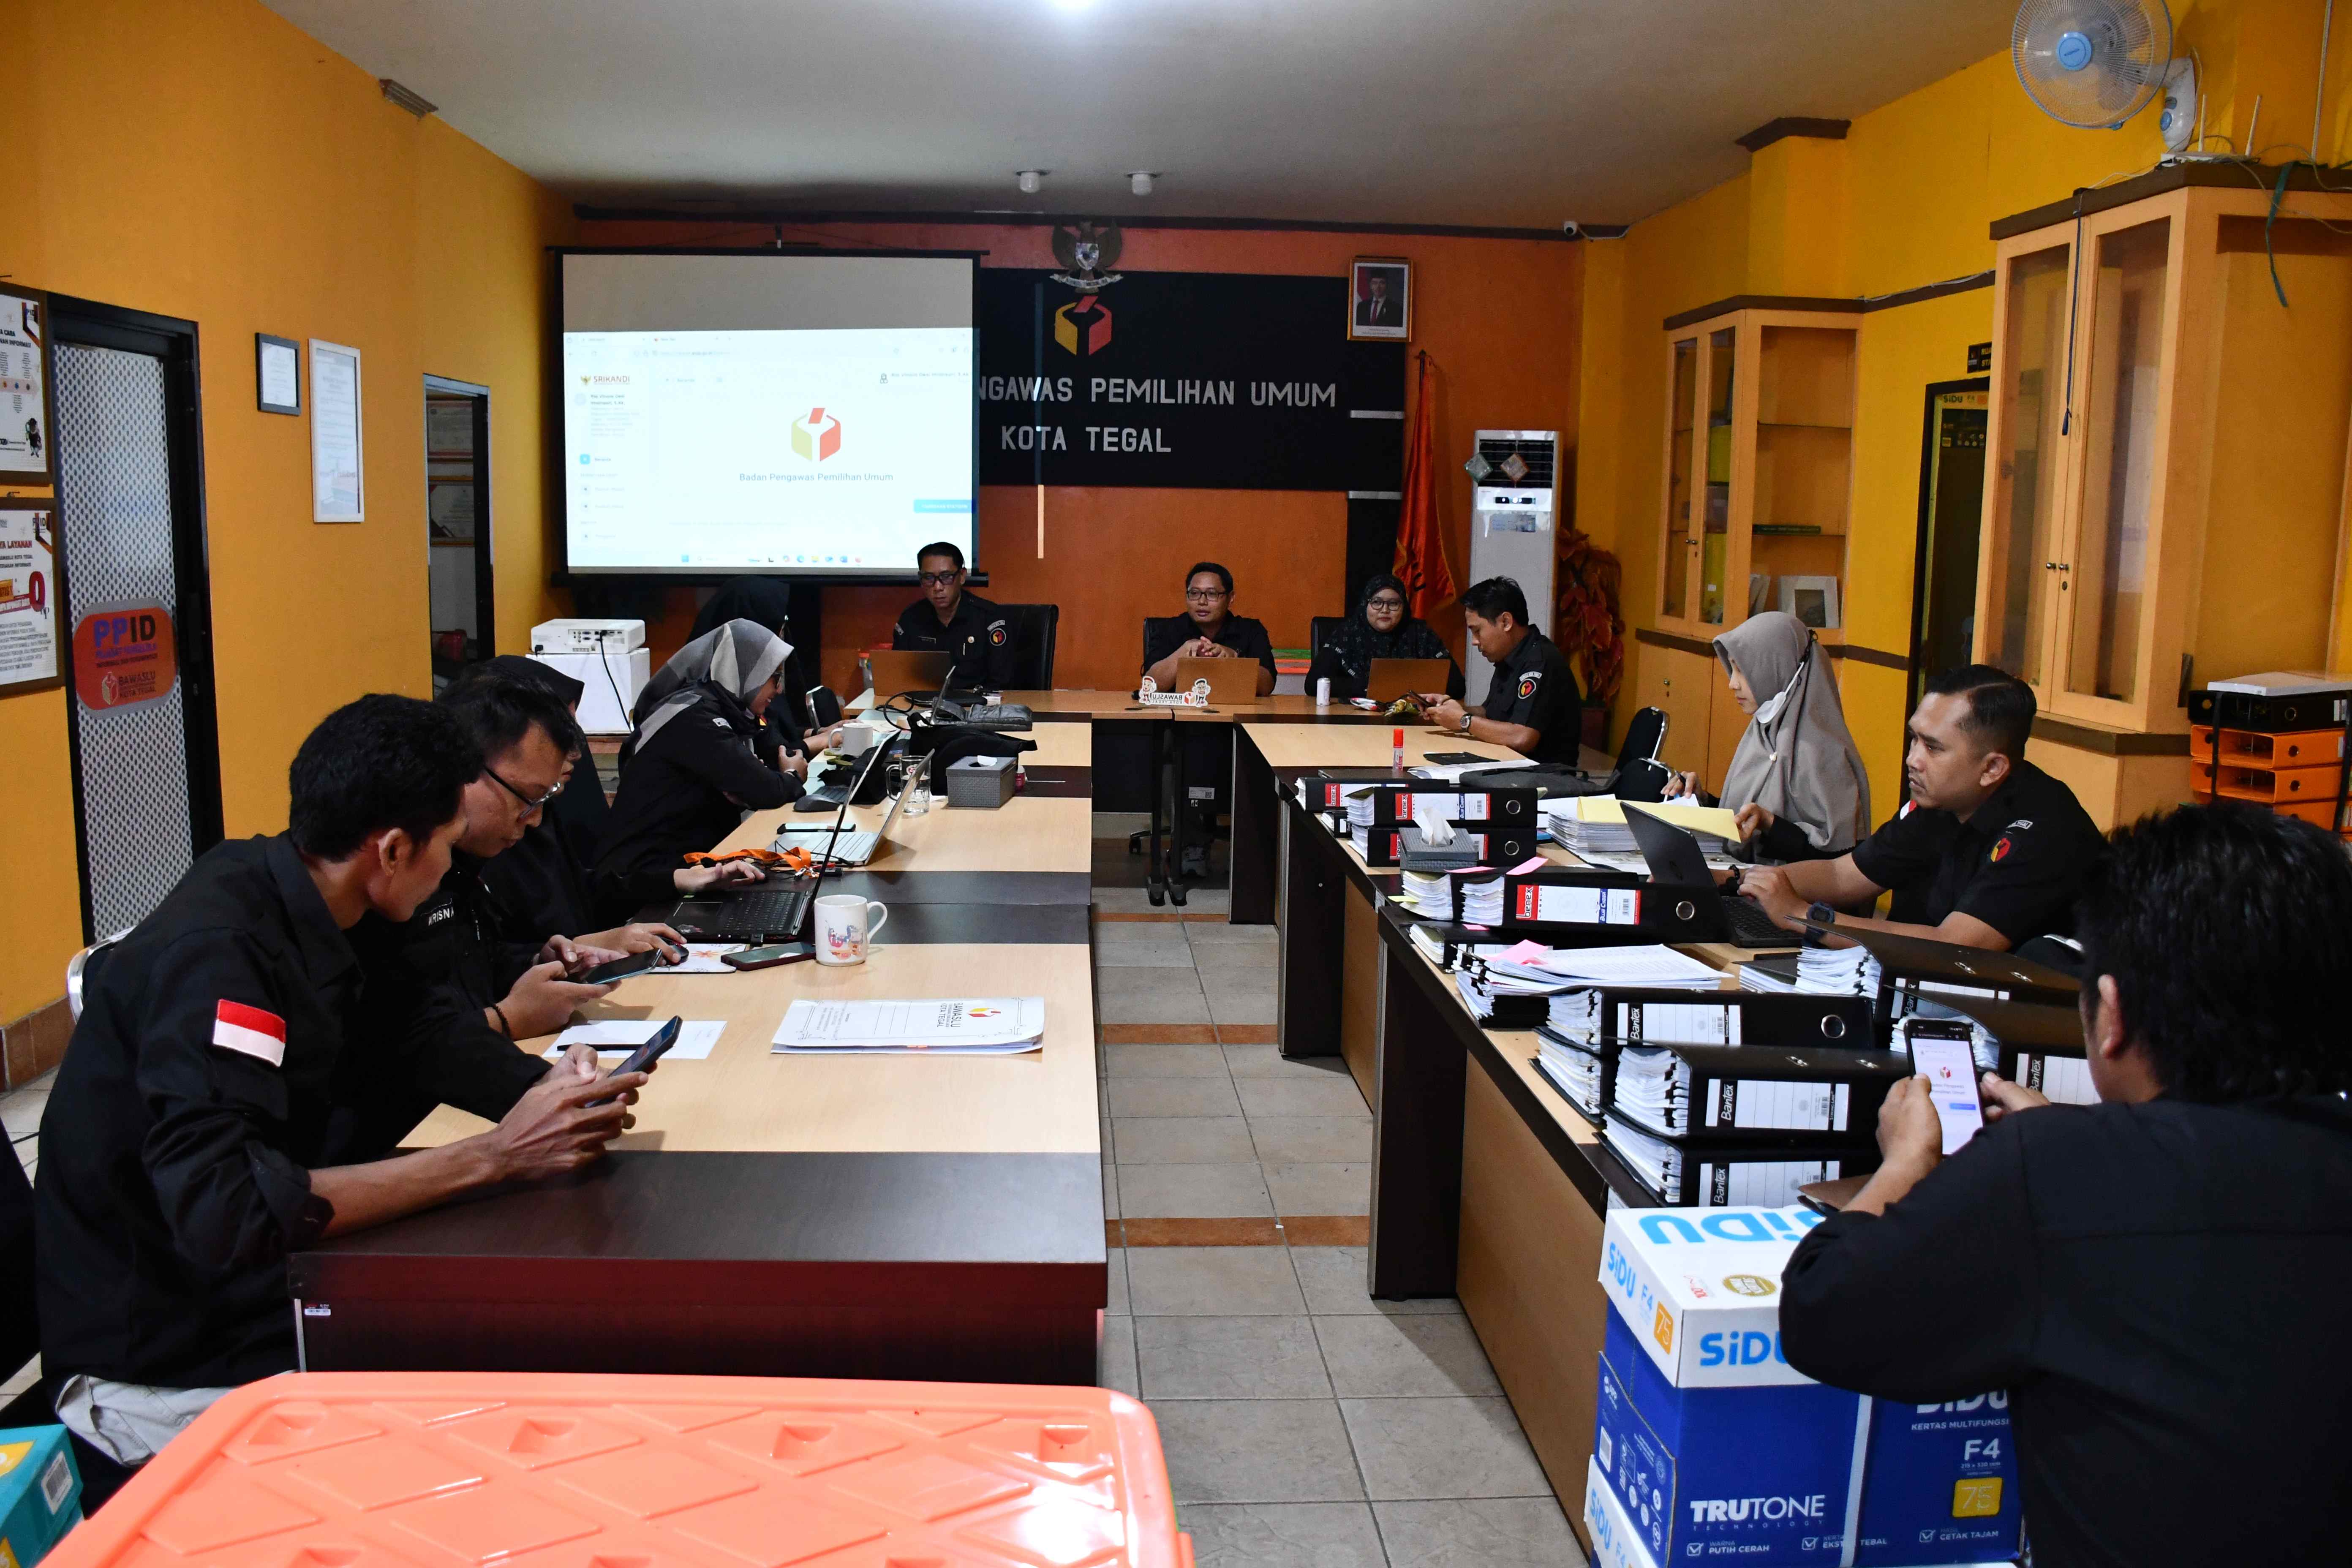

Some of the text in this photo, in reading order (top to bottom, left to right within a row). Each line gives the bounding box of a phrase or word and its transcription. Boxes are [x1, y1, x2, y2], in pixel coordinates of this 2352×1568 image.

[1091, 377, 1235, 406] PEMILIHAN
[1251, 381, 1336, 408] UMUM
[1001, 425, 1171, 452] KOTA TEGAL
[740, 473, 894, 483] Badan Pengawas Pemilihan Umum
[7, 541, 32, 549] LAYANAN
[29, 571, 45, 612] 0
[94, 615, 156, 648] PPID
[118, 670, 156, 686] BAWASLU
[1326, 785, 1337, 807] benex
[1396, 794, 1408, 819] benex
[1516, 886, 1534, 918] benex
[428, 906, 455, 926] KRISNA
[936, 1013, 946, 1027] TEGAL
[951, 1003, 964, 1027] BAWASLU
[1630, 1007, 1640, 1040] Bantex
[2029, 1059, 2041, 1091] Bantex
[1721, 1084, 1734, 1121] Bantex
[1714, 1168, 1726, 1204] Bantex
[1608, 1241, 1671, 1345] SiDU F4 75
[1911, 1418, 2009, 1430] KERTAS MULTIFUNGSI
[1964, 1437, 2001, 1461] F4
[1690, 1494, 1826, 1522] TRUTONE
[1961, 1485, 1994, 1511] 75
[1590, 1488, 1612, 1550] SiDU
[1693, 1520, 1824, 1531] TECHNOLOGY
[1822, 1538, 1887, 1549] EKST TEBAL
[1940, 1530, 1999, 1541] CETAK TAJAM
[1708, 1544, 1769, 1554] PUTIH CERAH
